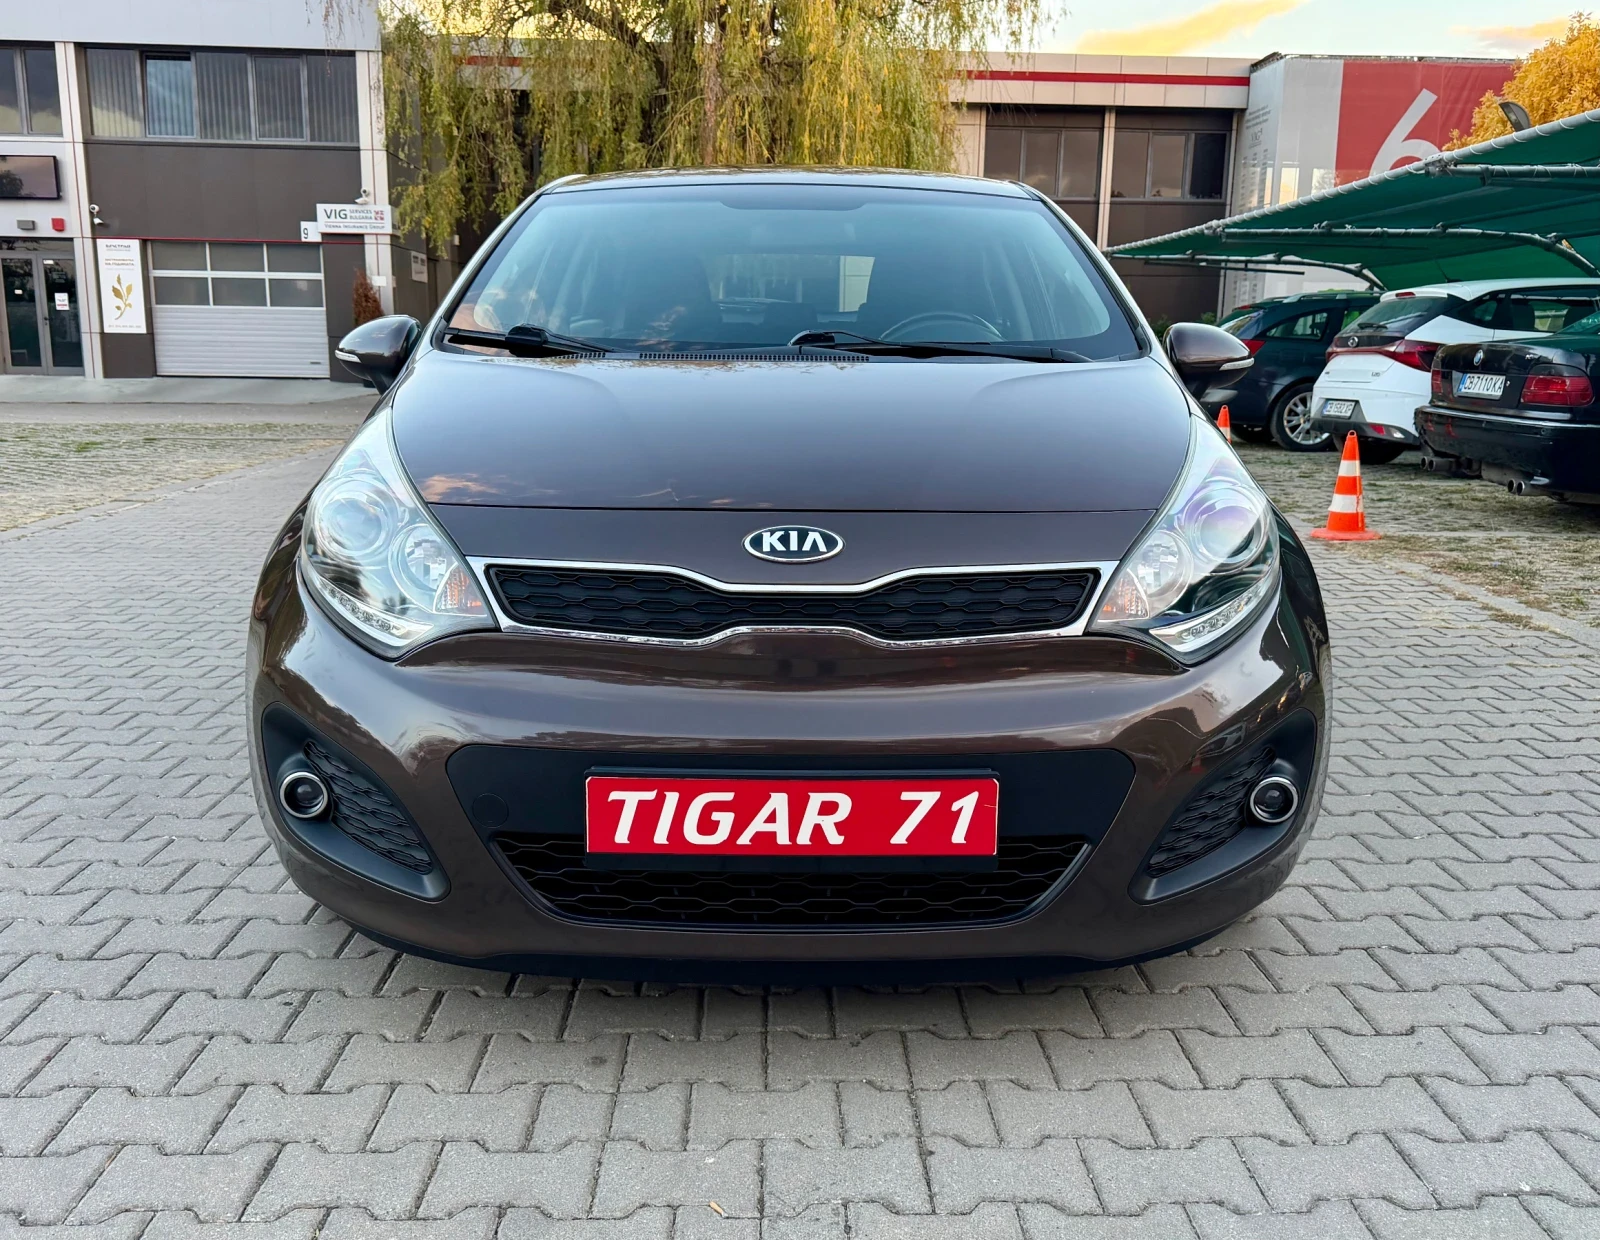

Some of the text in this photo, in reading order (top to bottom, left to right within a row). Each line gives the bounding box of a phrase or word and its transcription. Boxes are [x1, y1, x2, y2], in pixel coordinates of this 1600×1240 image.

[1368, 88, 1441, 177] 6
[324, 209, 348, 220] VIG
[302, 227, 309, 240] 9
[761, 530, 828, 553] KIA
[607, 788, 980, 846] TIGAR 71
